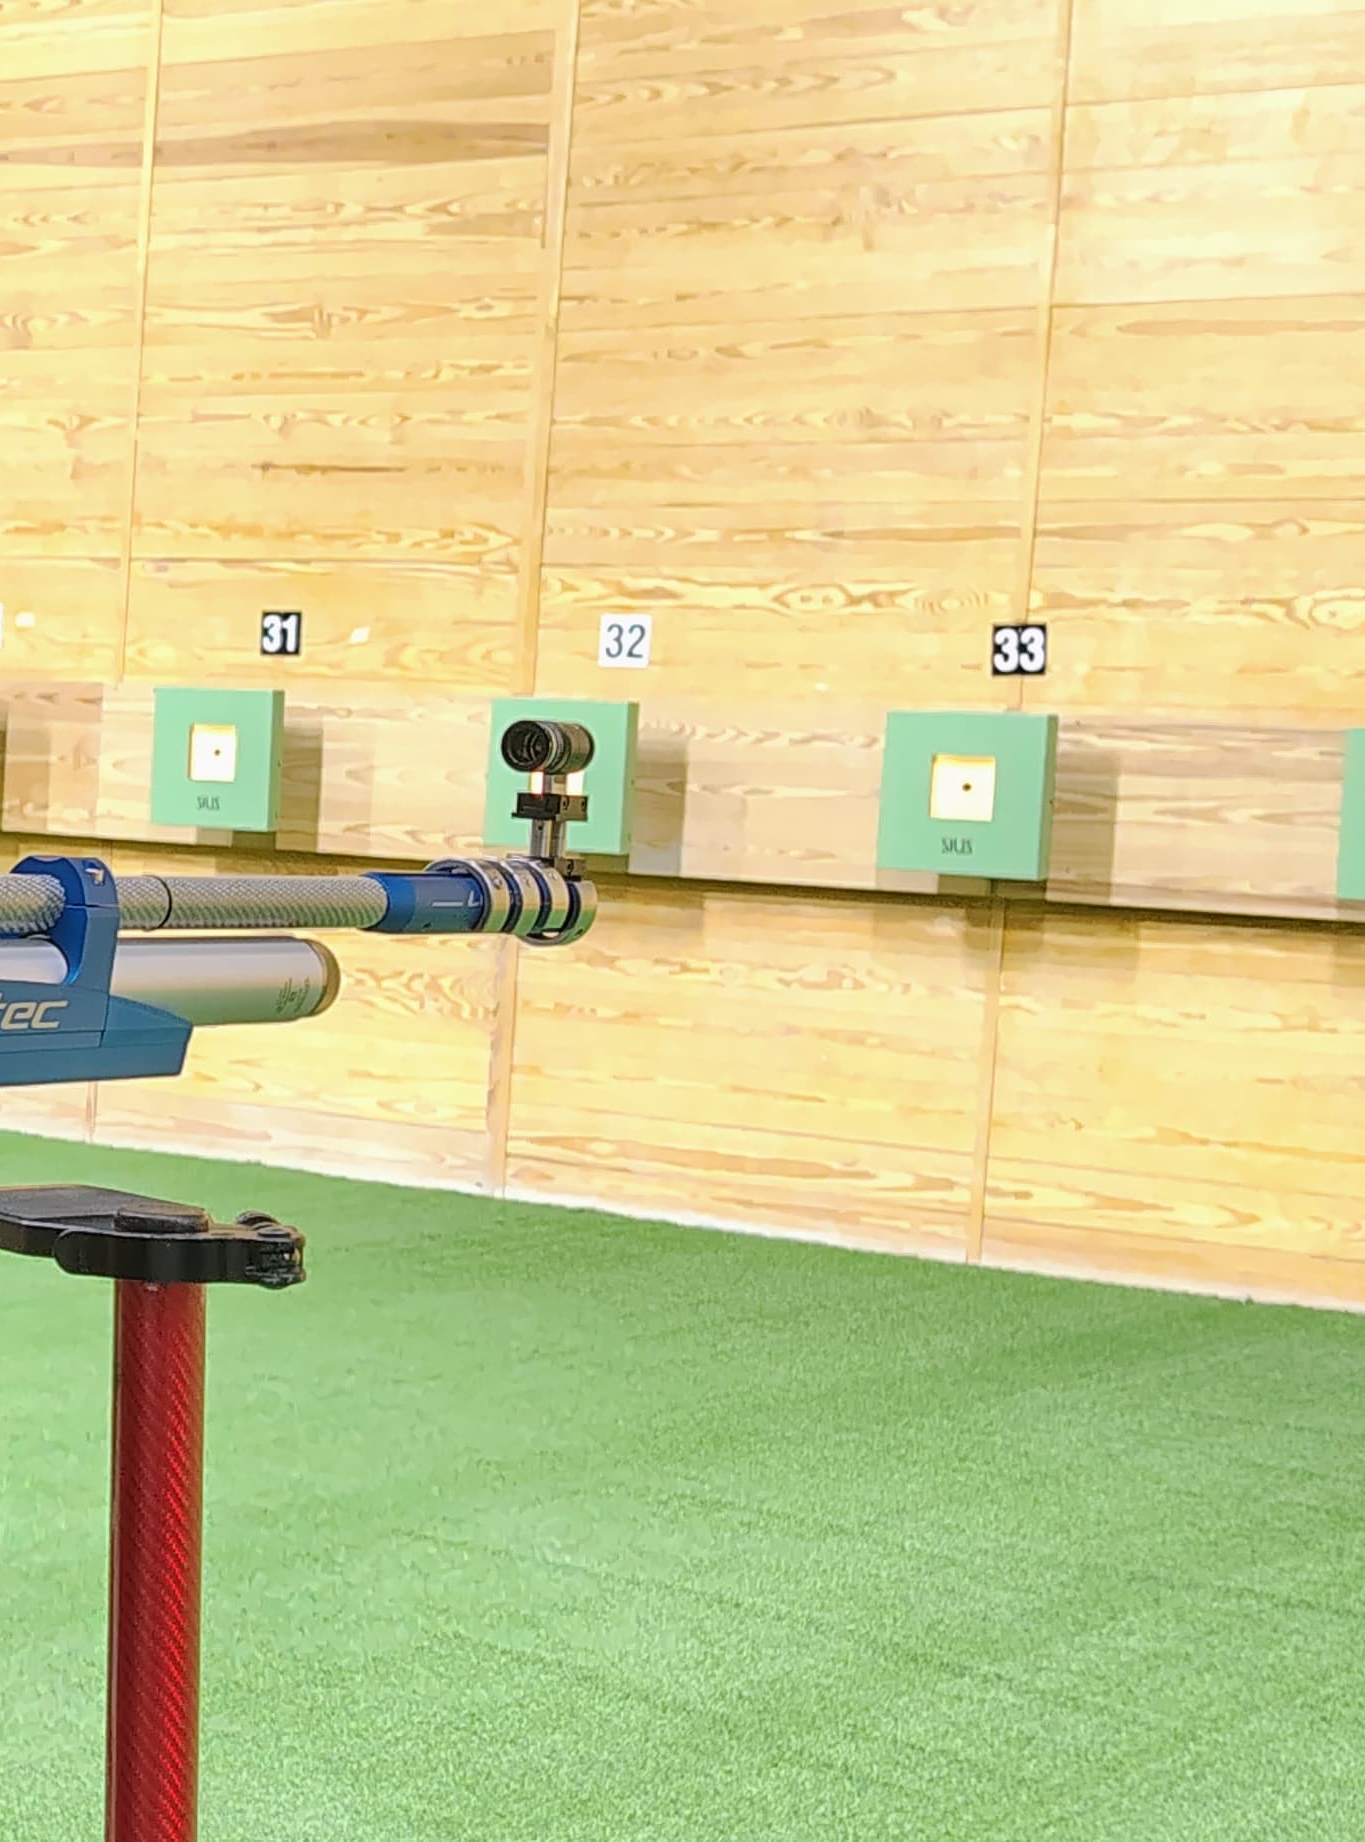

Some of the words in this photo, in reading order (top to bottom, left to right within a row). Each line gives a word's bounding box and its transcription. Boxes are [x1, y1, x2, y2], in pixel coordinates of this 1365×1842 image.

[262, 613, 298, 653] 31
[605, 623, 646, 659] 32
[993, 627, 1045, 673] 33
